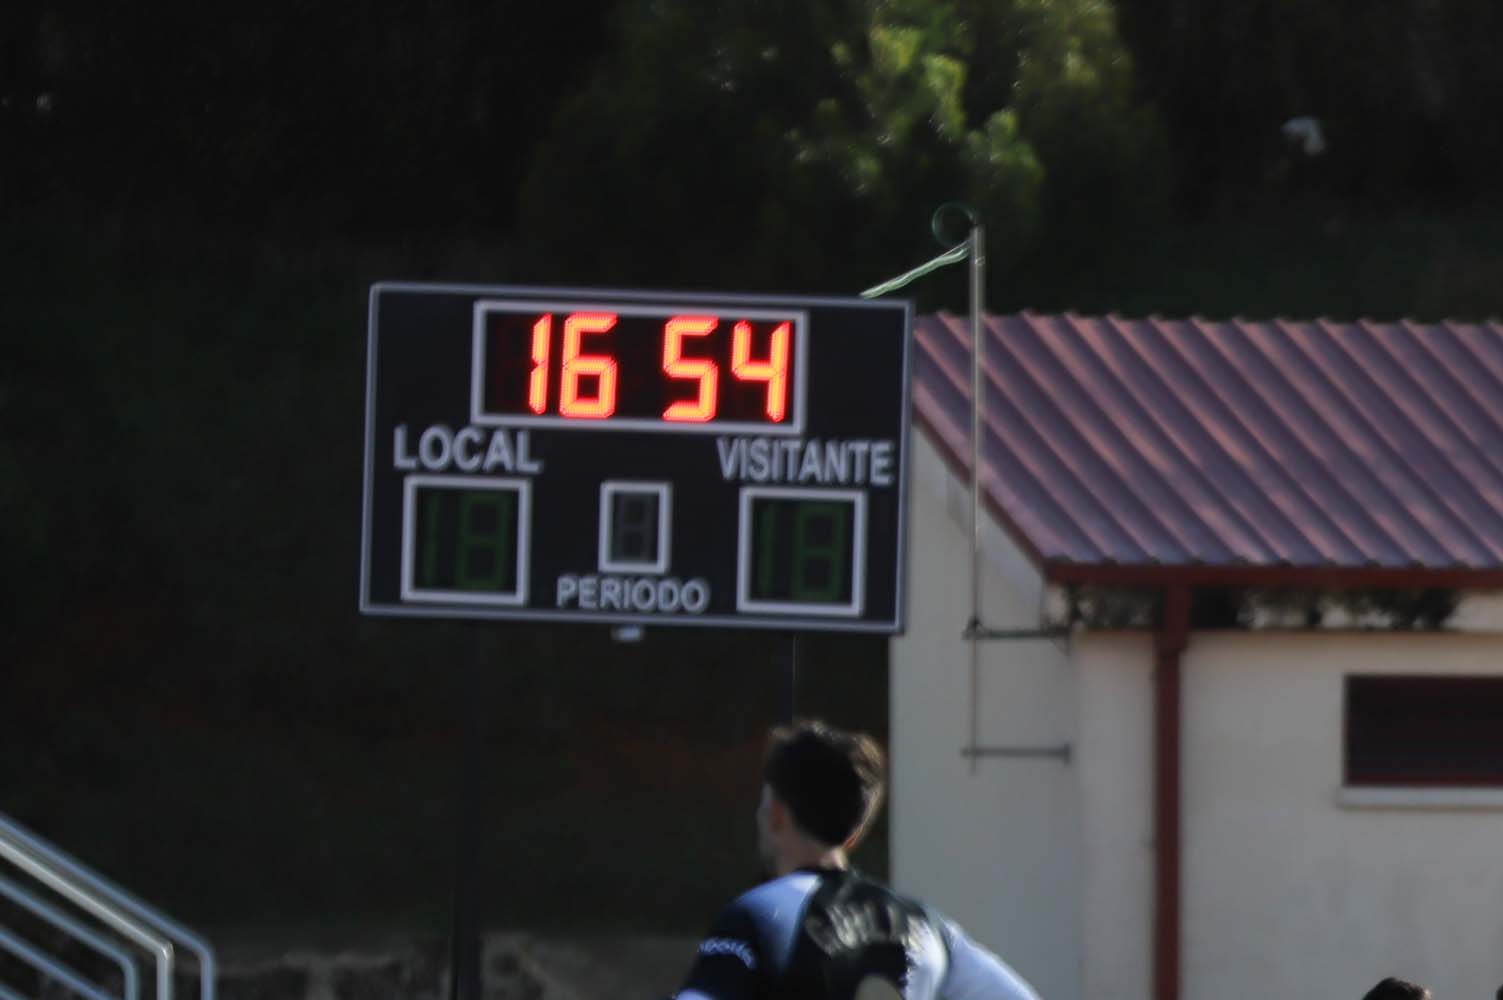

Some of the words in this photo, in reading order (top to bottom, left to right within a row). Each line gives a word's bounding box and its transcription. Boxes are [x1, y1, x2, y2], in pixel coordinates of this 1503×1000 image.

[528, 311, 618, 419] 16
[662, 314, 791, 423] 54
[393, 426, 542, 474] LOCAL
[716, 437, 895, 486] VISITANTE
[556, 574, 710, 612] PERIODO
